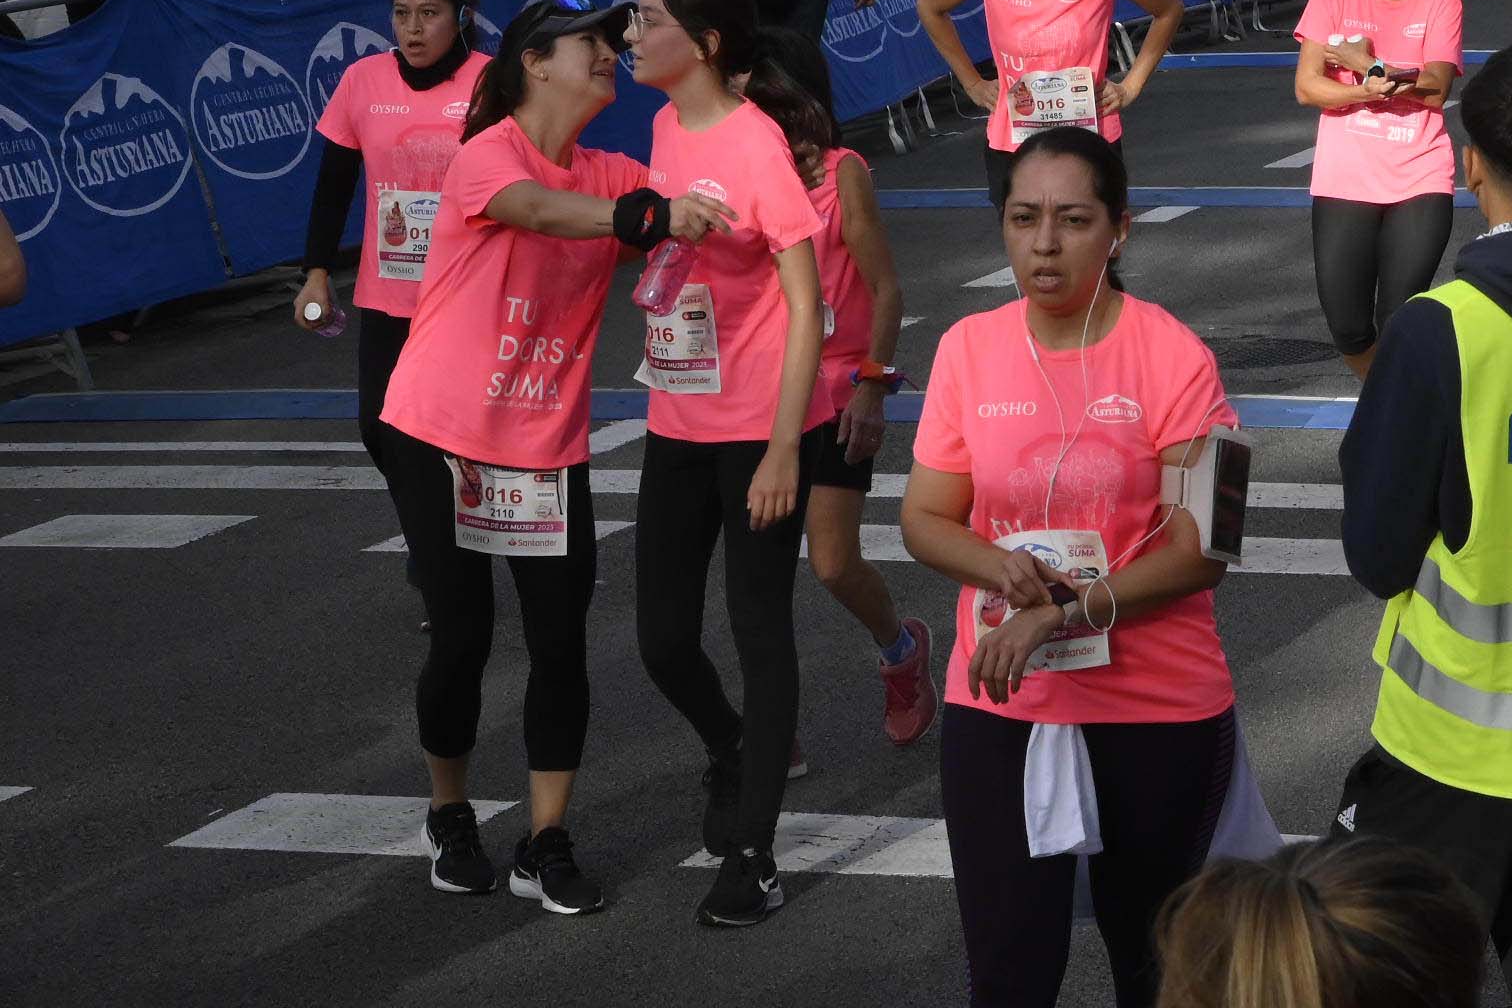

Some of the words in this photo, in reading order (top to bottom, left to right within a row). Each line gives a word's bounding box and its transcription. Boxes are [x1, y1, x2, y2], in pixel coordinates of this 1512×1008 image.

[1000, 50, 1025, 72] TU
[369, 103, 411, 115] OYSHO
[1036, 98, 1066, 111] 016
[1039, 112, 1064, 121] 31485
[202, 98, 308, 154] ASTURIANA
[1386, 125, 1415, 143] 2019
[72, 128, 184, 189] ASTURIANA
[408, 204, 438, 216] ASTURIA
[408, 227, 432, 240] 01
[411, 244, 429, 252] 290
[506, 296, 539, 326] TU
[486, 372, 559, 401] SUMA
[675, 375, 712, 385] Santander
[977, 401, 1038, 419] OYSHO
[485, 486, 524, 504] 016
[490, 507, 515, 519] 2110
[461, 531, 490, 545] OYSHO
[517, 539, 557, 547] Santander
[1067, 548, 1097, 559] SUMA
[1052, 645, 1097, 660] Santander
